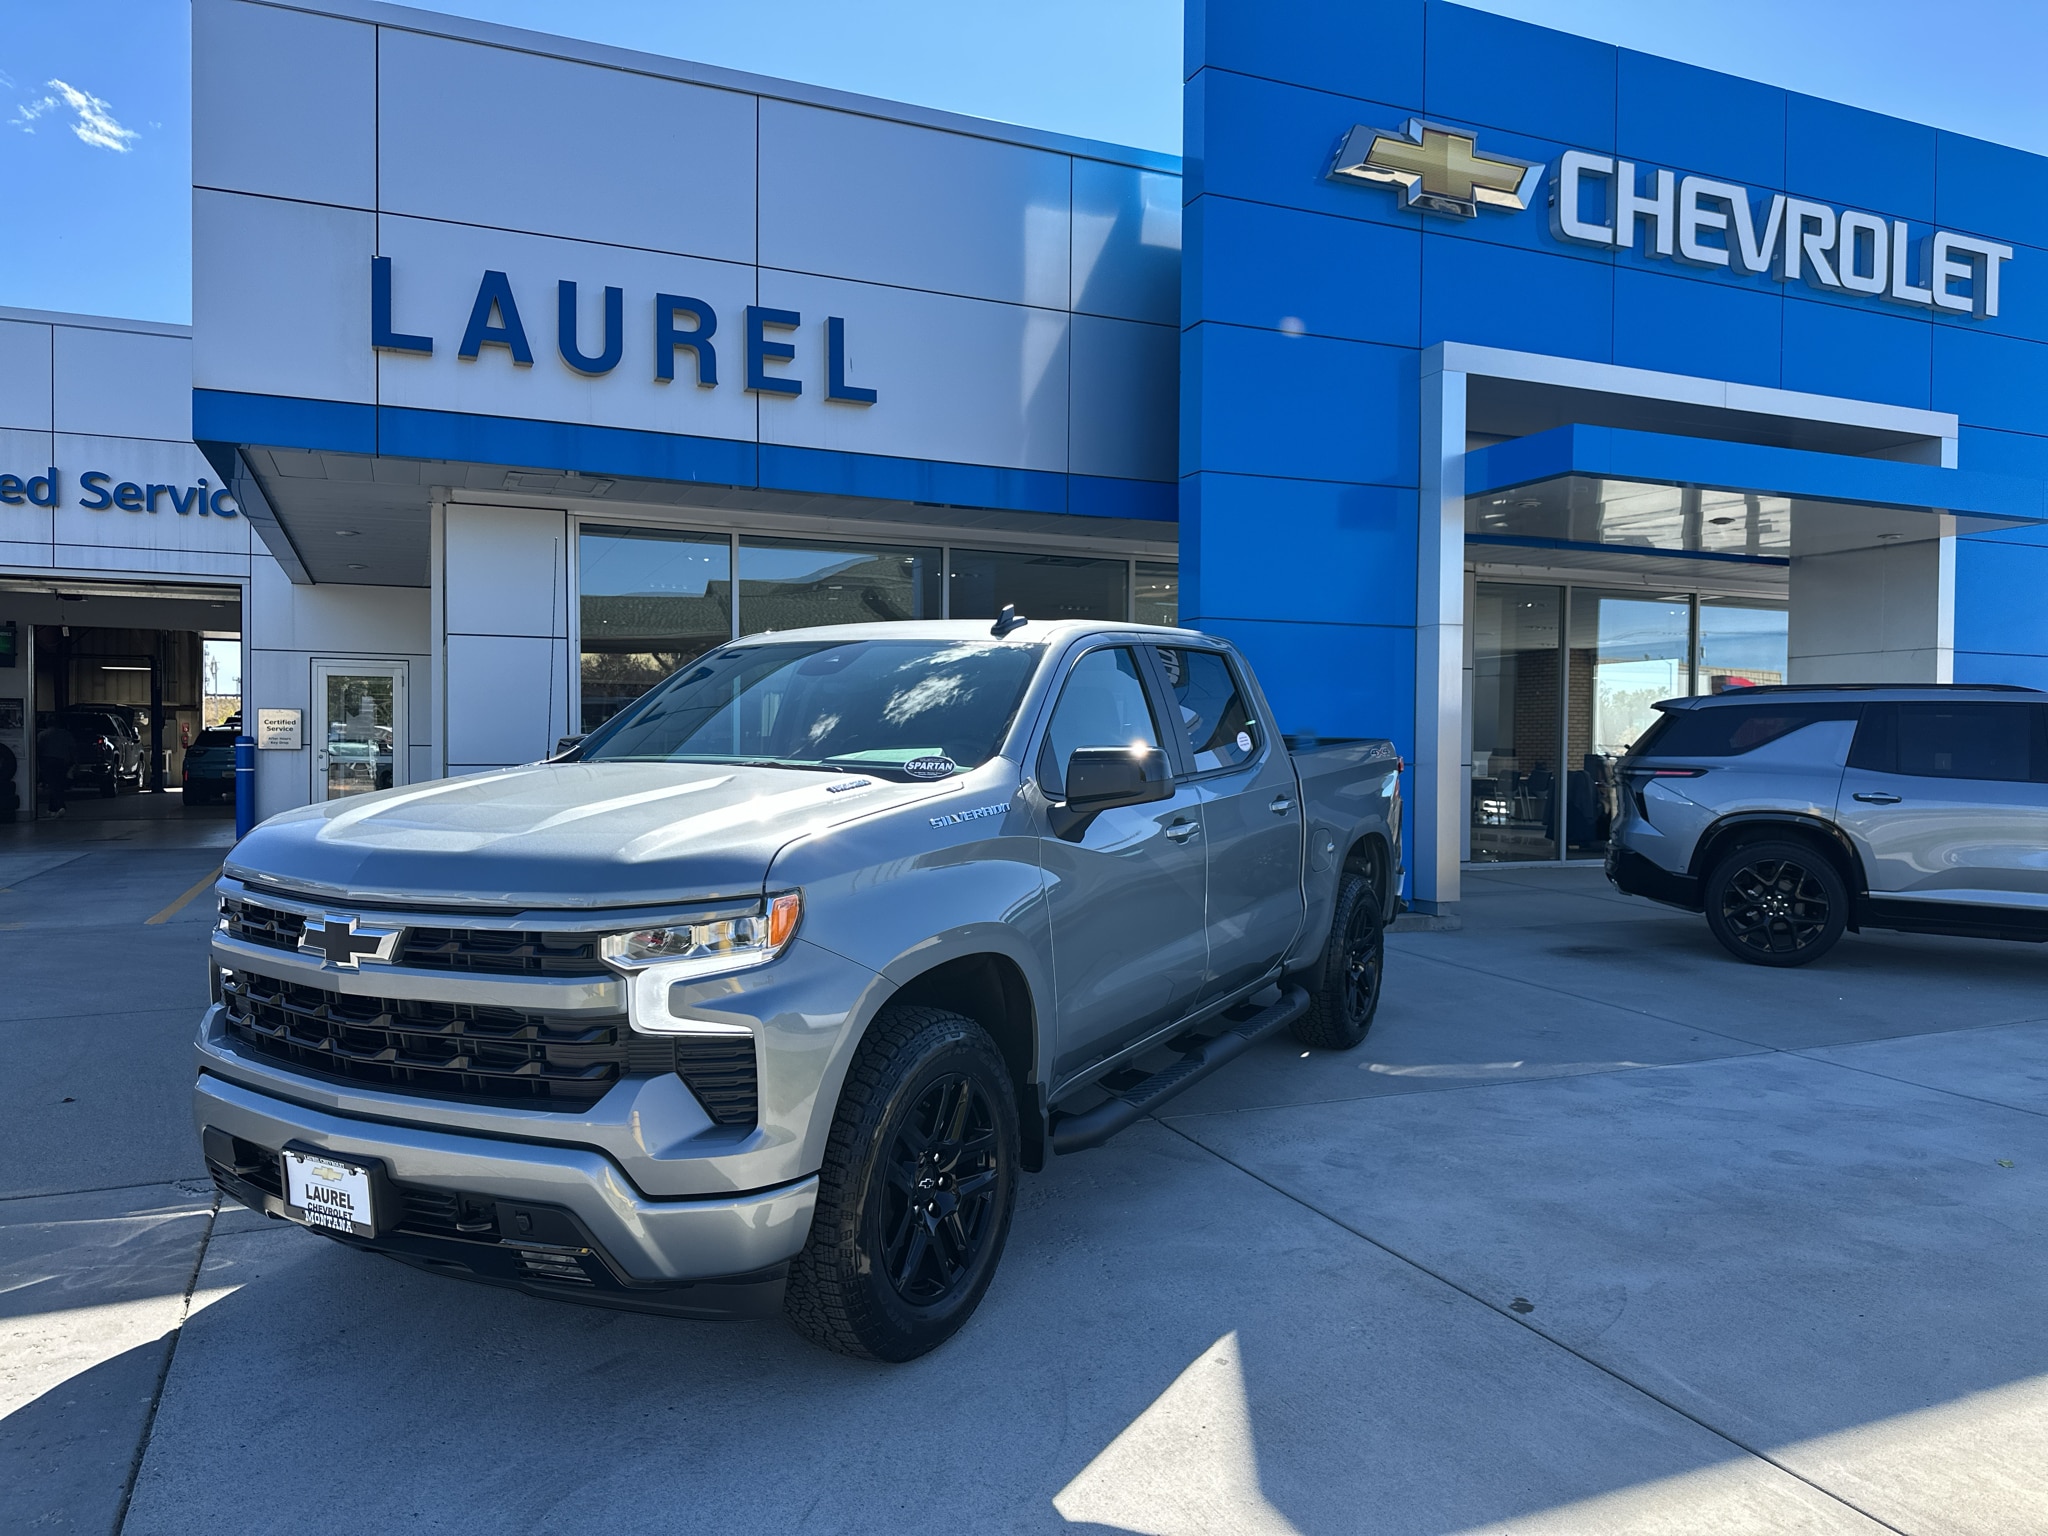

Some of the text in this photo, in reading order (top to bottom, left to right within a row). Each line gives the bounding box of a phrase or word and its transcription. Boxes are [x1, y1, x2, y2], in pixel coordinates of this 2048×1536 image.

[1551, 149, 2013, 320] CHEVROLET
[371, 255, 878, 407] LAUREL
[907, 761, 953, 770] SPARTAN
[305, 1184, 354, 1210] LAUREL
[305, 1211, 353, 1233] MONTANA
[307, 1202, 353, 1221] CHEVROLET
